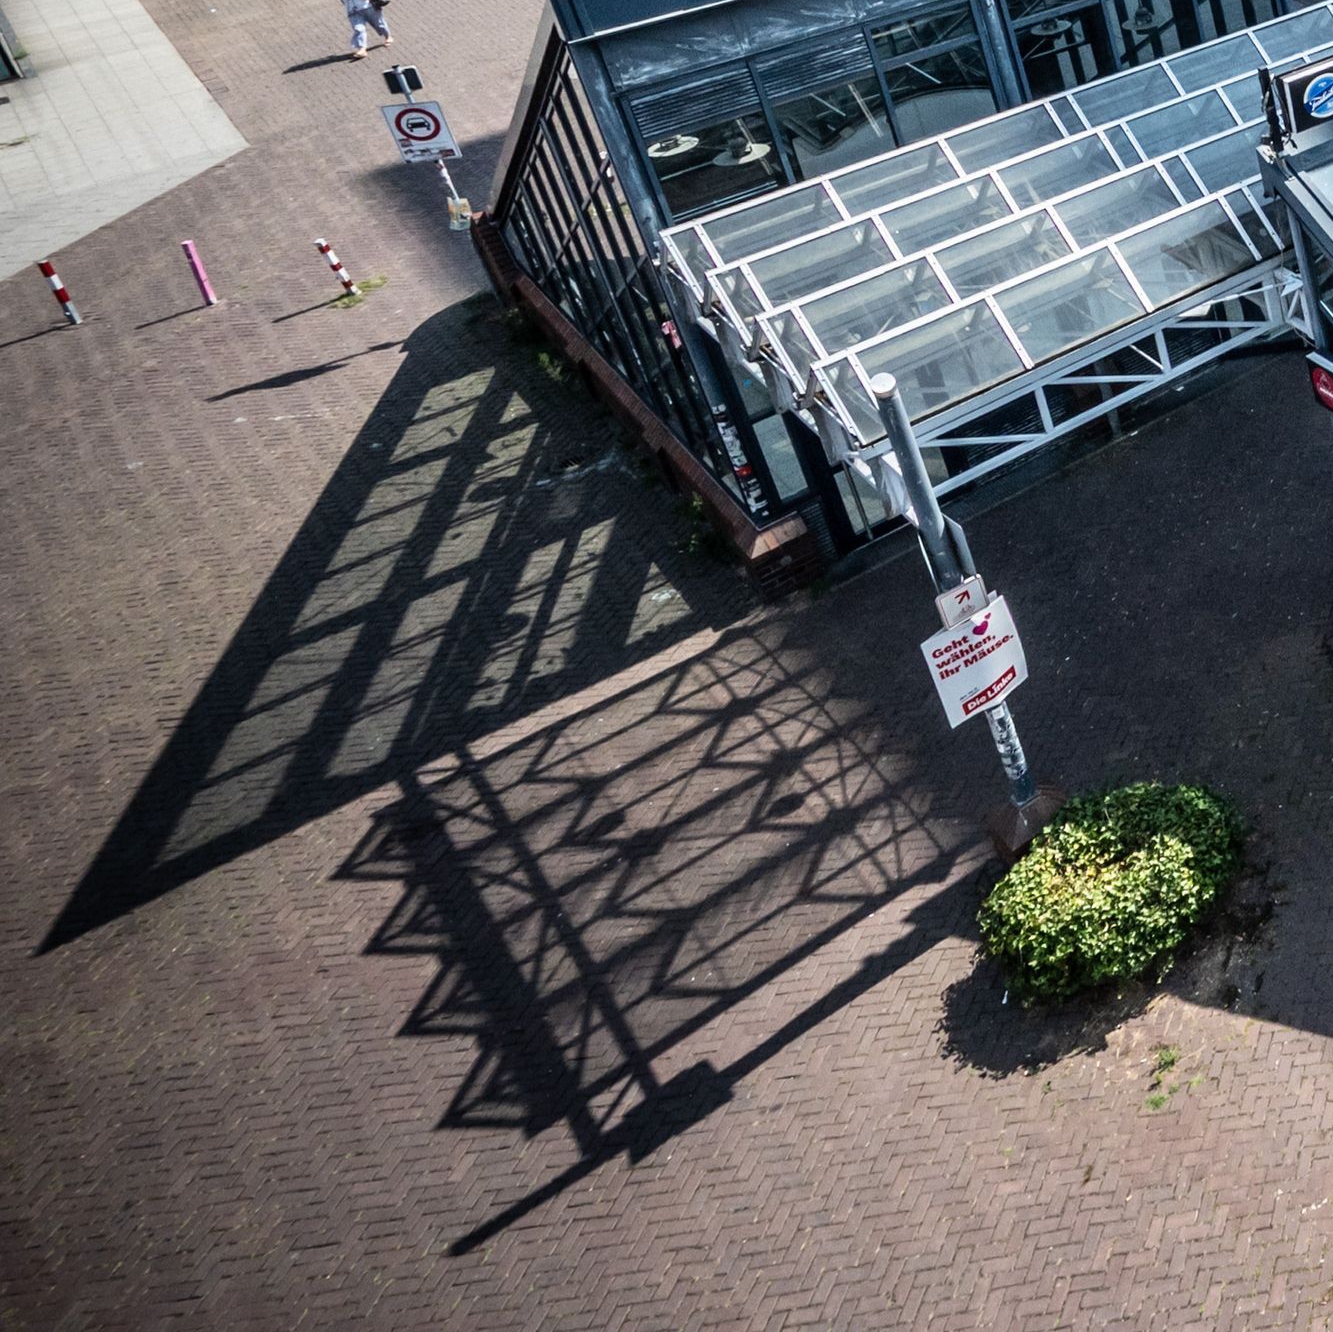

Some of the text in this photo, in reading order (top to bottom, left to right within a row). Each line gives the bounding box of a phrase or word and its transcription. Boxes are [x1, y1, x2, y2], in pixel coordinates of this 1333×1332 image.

[931, 636, 969, 659] Geht
[936, 634, 996, 670] wählen,
[939, 634, 1014, 680] ihr Mäuse.
[967, 696, 987, 711] Die
[987, 672, 1013, 699] Linke
